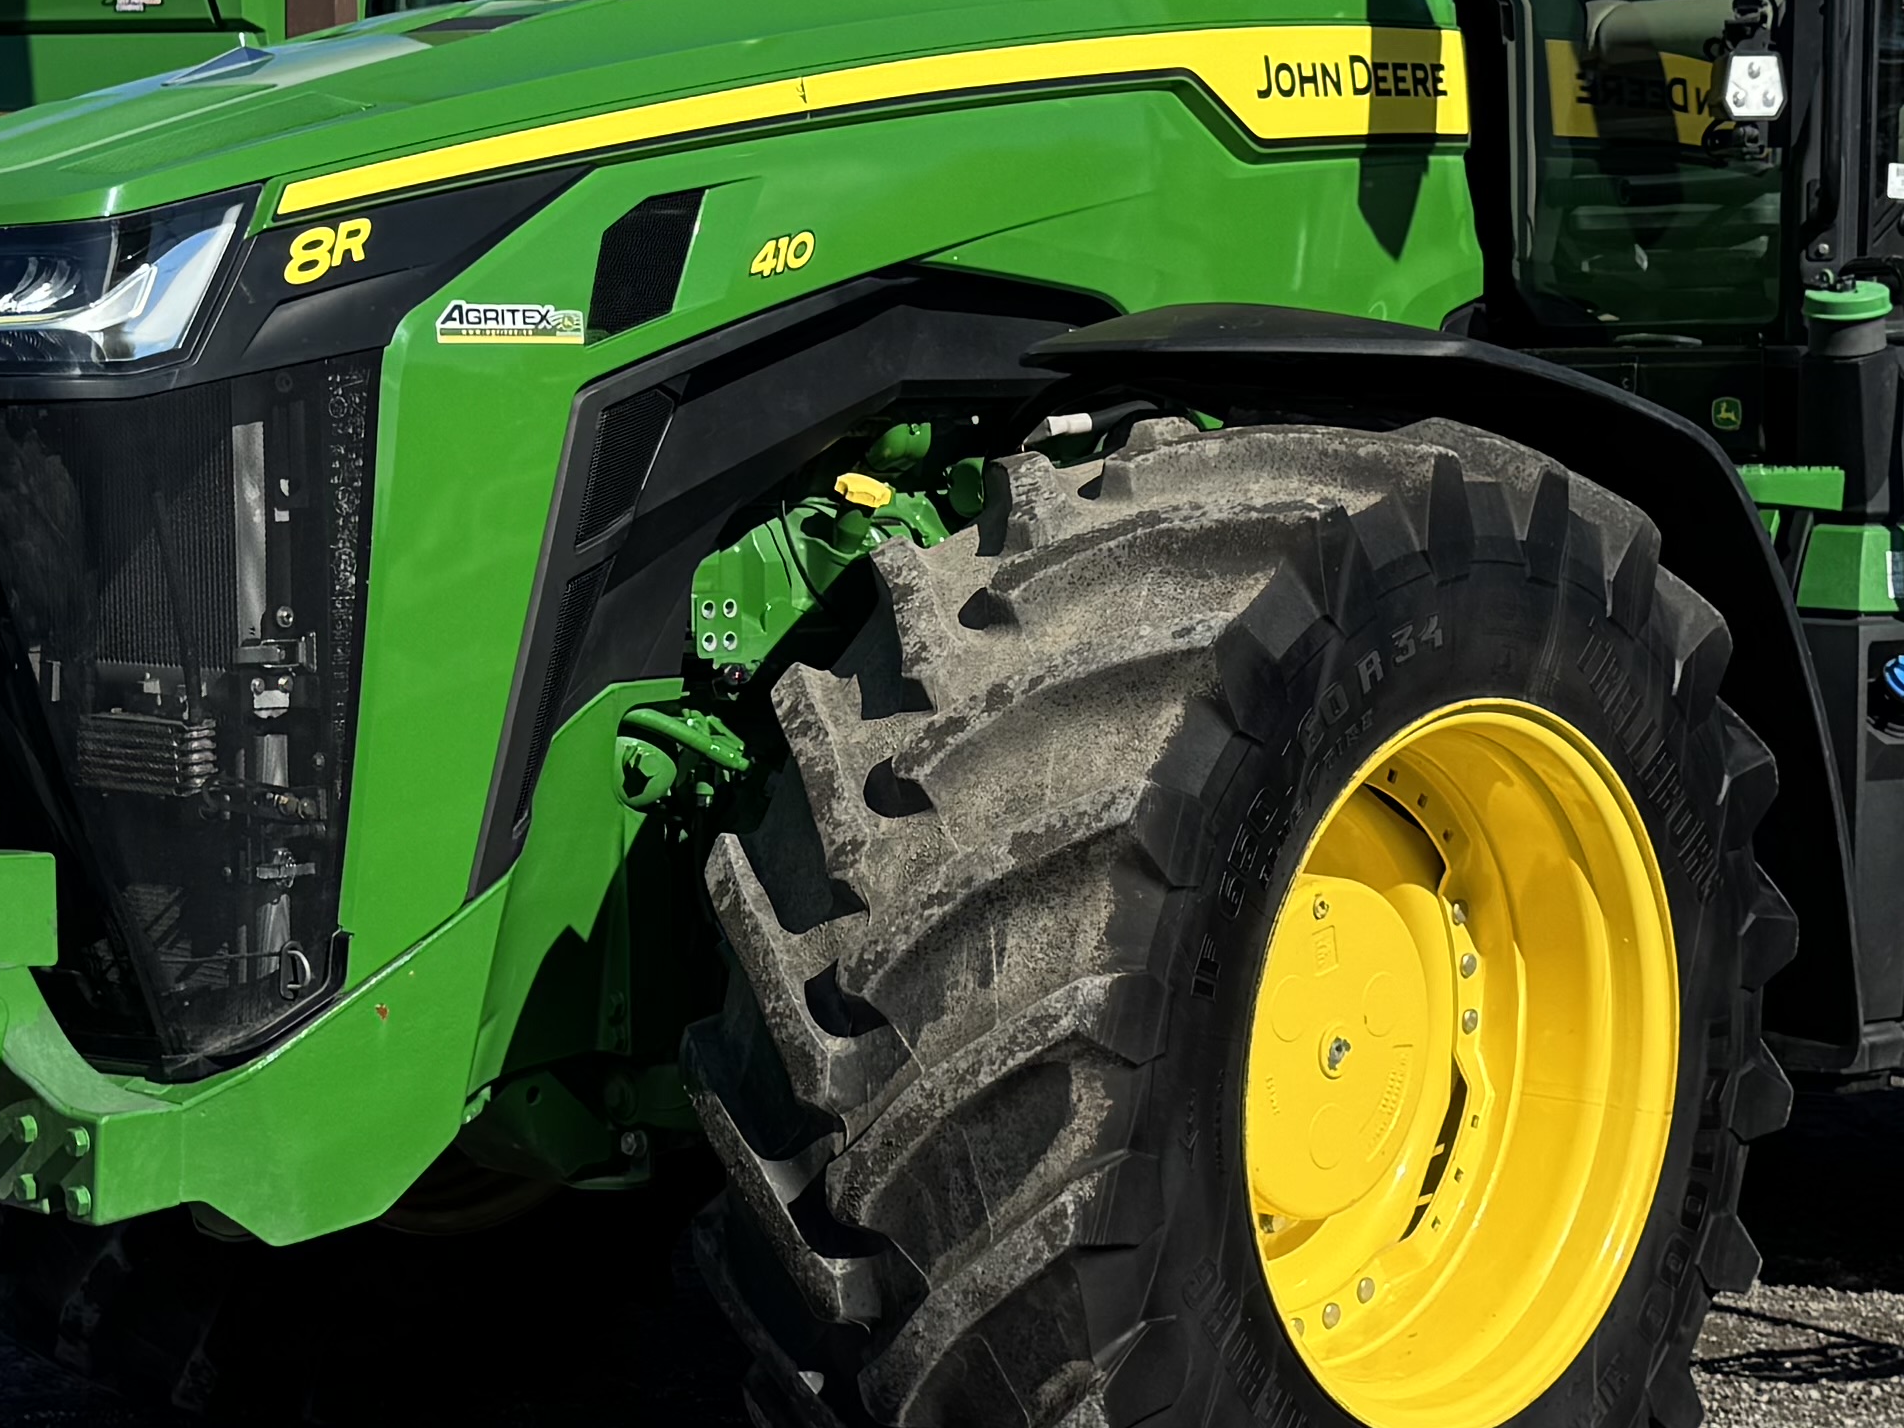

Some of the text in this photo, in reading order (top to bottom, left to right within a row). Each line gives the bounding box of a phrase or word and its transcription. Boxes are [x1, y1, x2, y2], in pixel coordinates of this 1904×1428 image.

[1256, 54, 1449, 100] JOHN DEERE
[283, 217, 373, 285] 8R
[748, 229, 816, 279] 410
[440, 304, 554, 326] AGRITEX
[1388, 611, 1444, 668] 34
